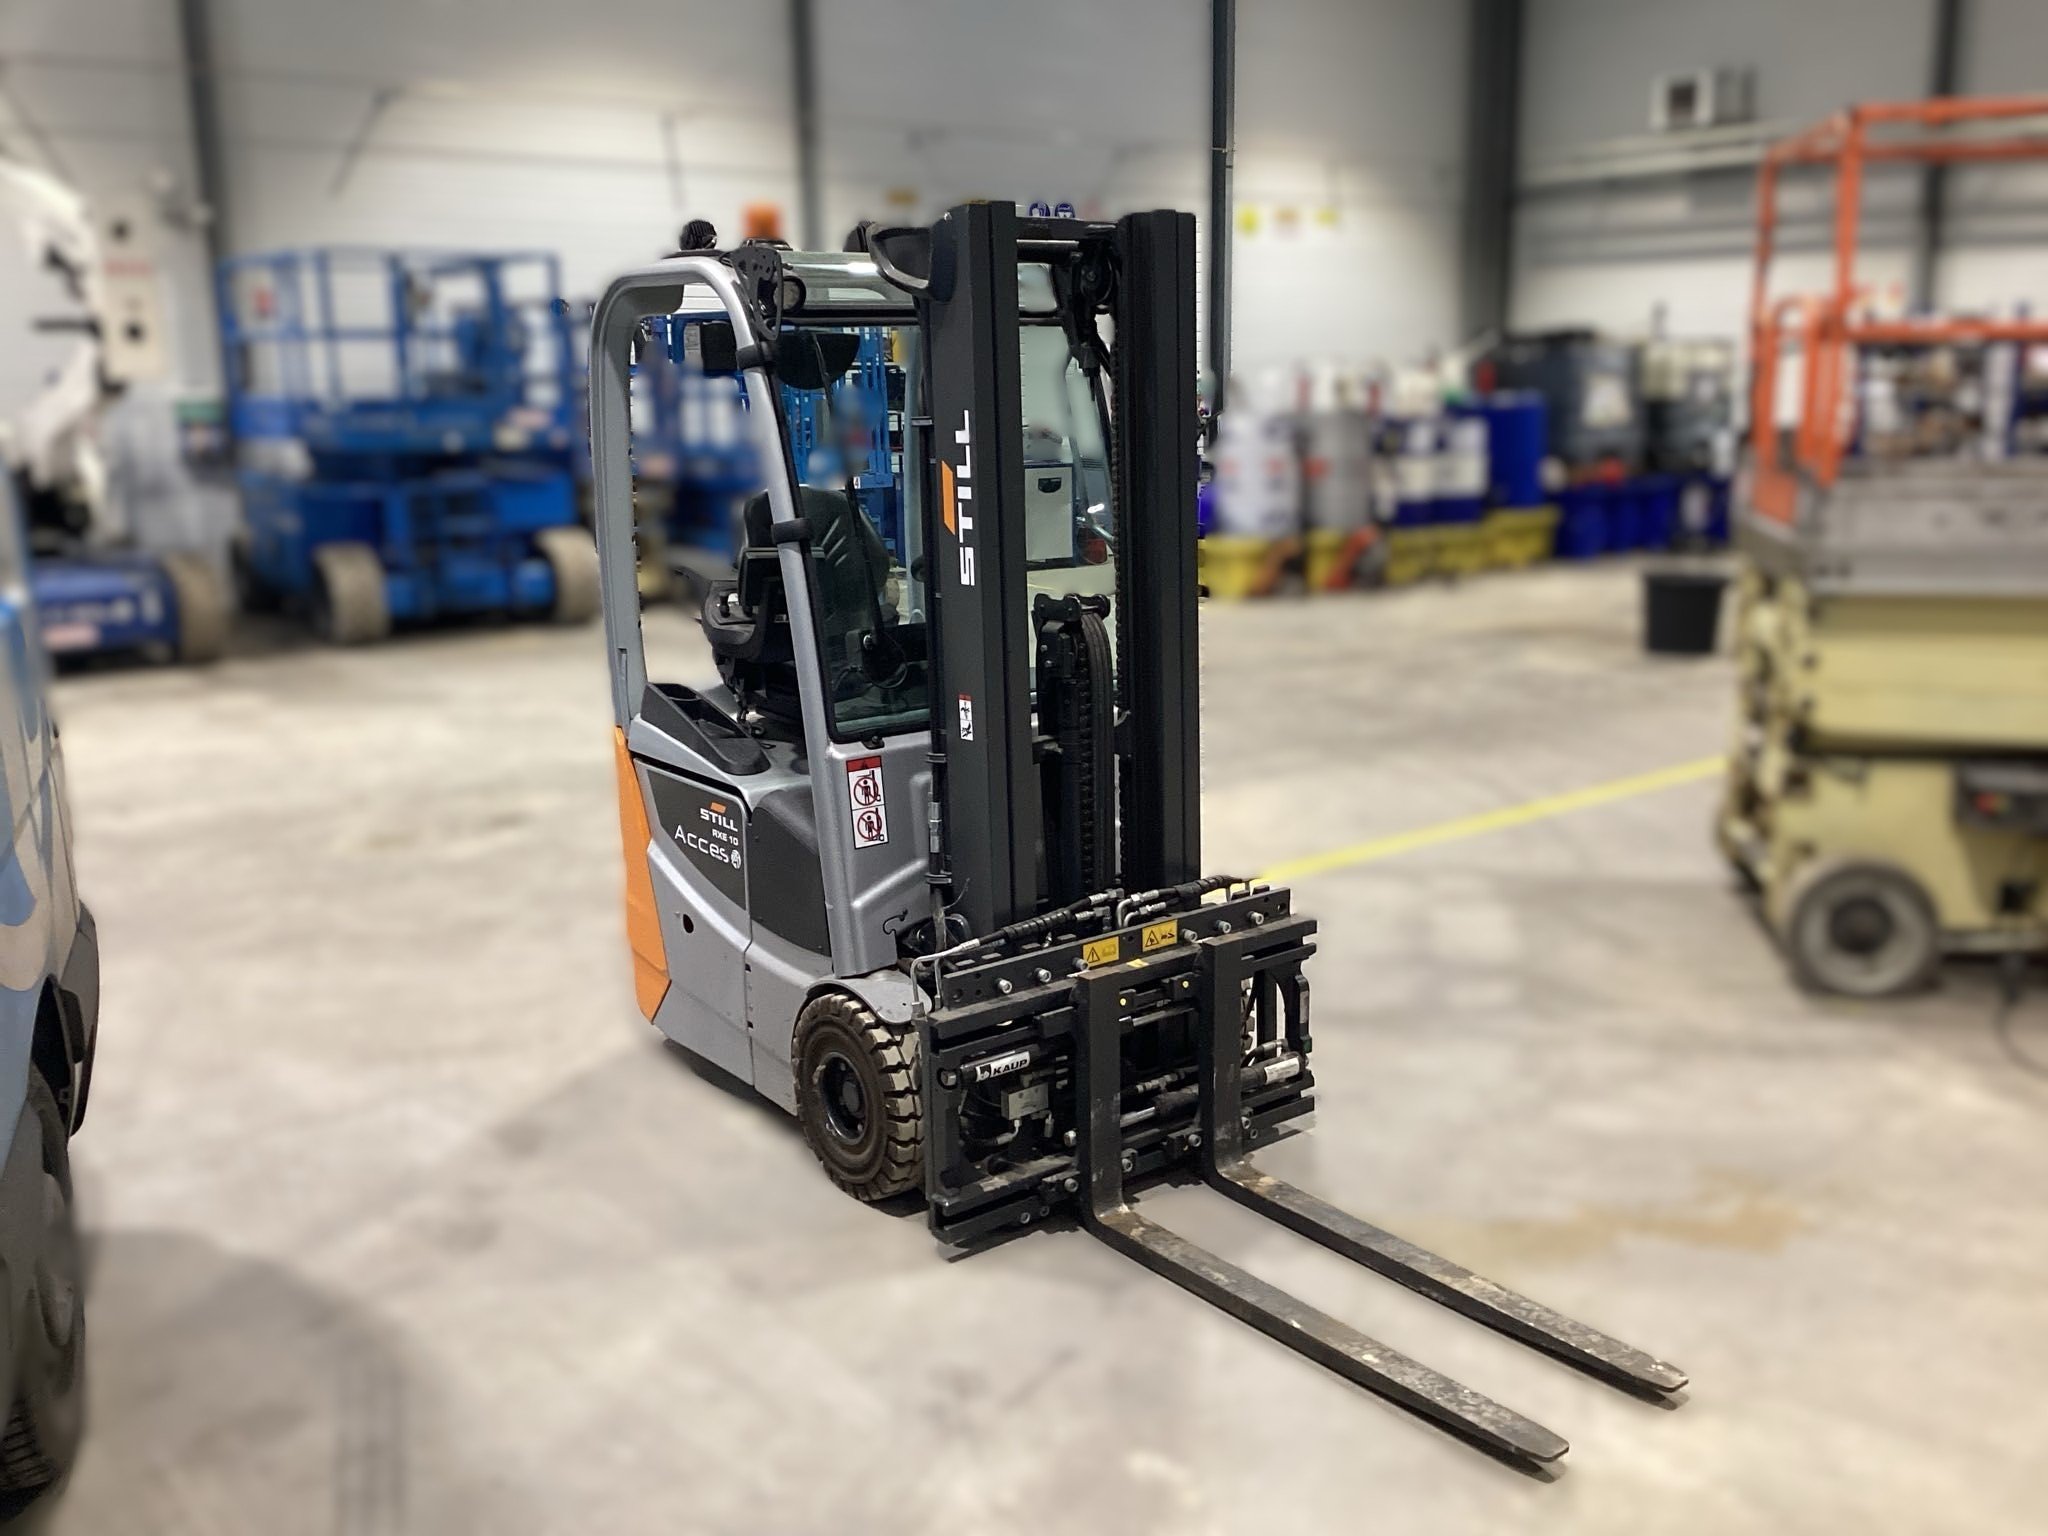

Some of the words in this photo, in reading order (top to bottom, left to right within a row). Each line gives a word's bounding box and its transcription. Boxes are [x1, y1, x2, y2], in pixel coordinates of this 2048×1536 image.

[955, 410, 975, 586] STILL
[700, 808, 738, 832] STILL
[712, 829, 727, 842] RXE
[729, 836, 738, 846] 10
[993, 1059, 1028, 1075] KAUP
